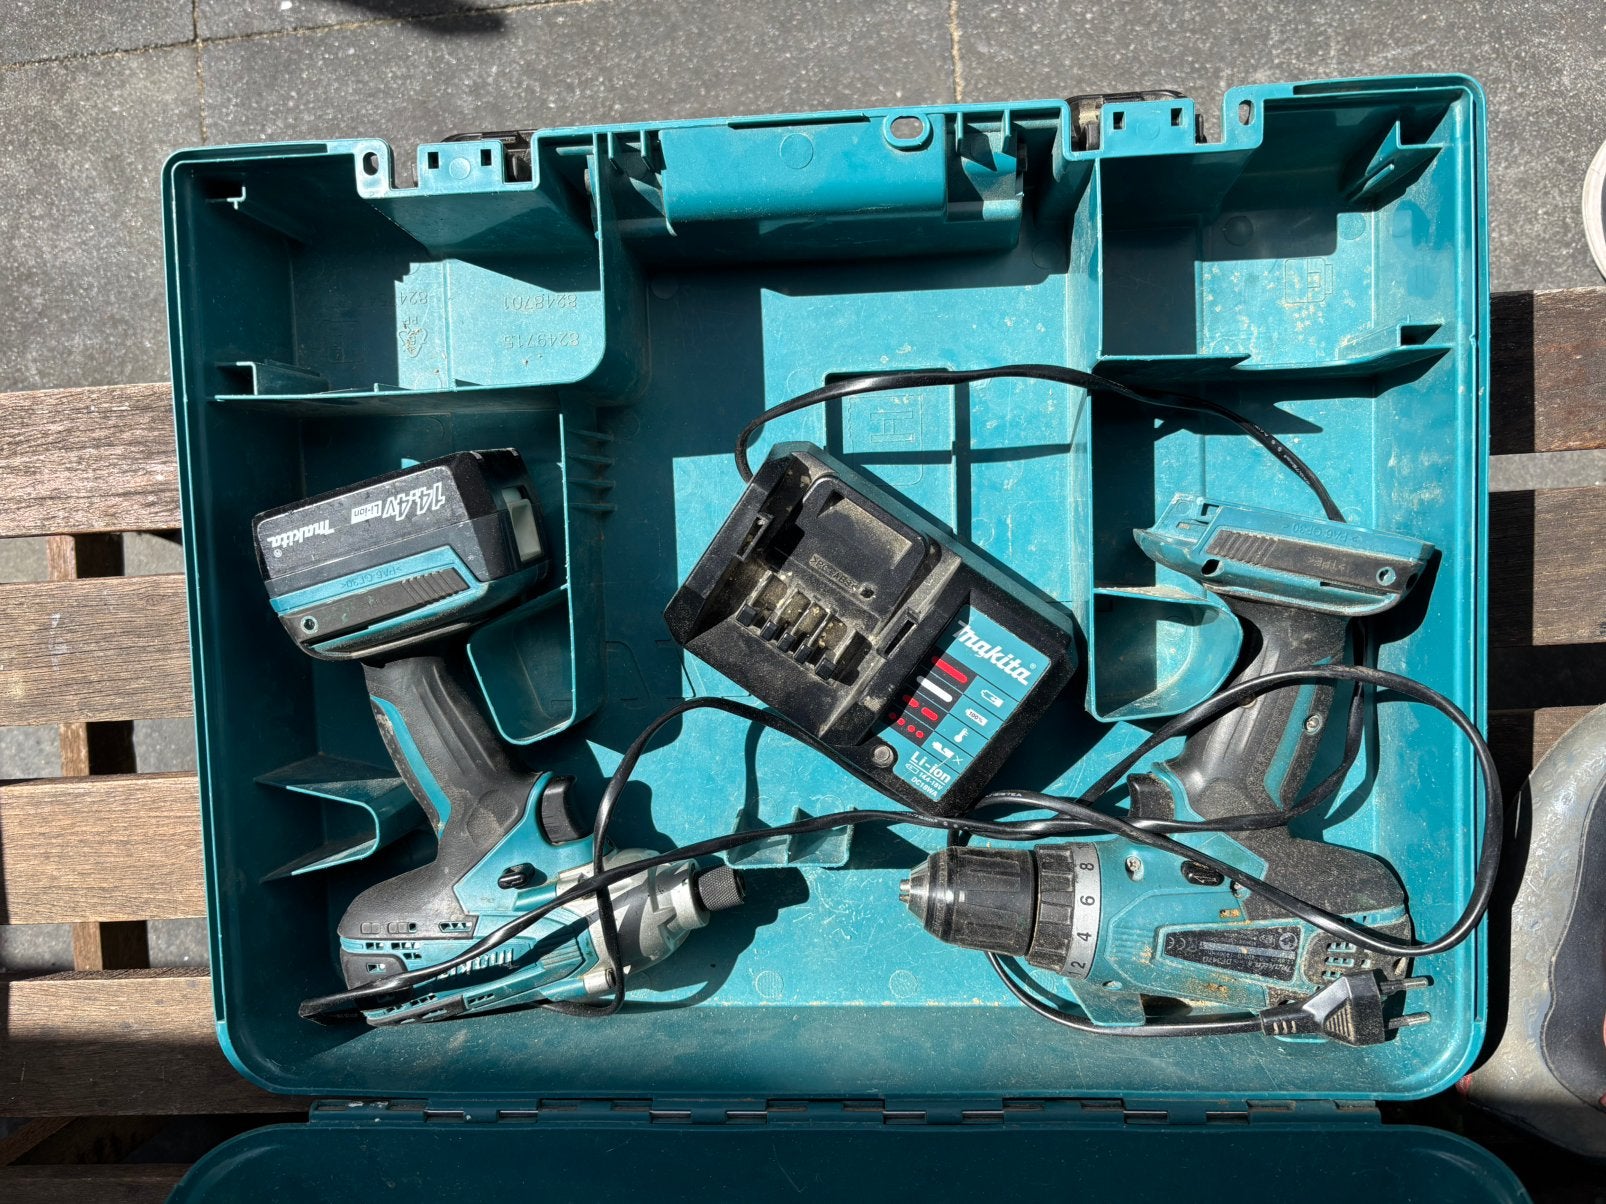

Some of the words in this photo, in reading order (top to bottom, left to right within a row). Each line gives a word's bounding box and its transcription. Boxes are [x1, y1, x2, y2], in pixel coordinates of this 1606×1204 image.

[910, 751, 952, 783] Li-ion
[911, 776, 938, 798] DC18WA
[1080, 863, 1094, 871] 8
[1080, 895, 1095, 906] 6
[1077, 932, 1092, 942] 4
[1070, 961, 1086, 970] 2
